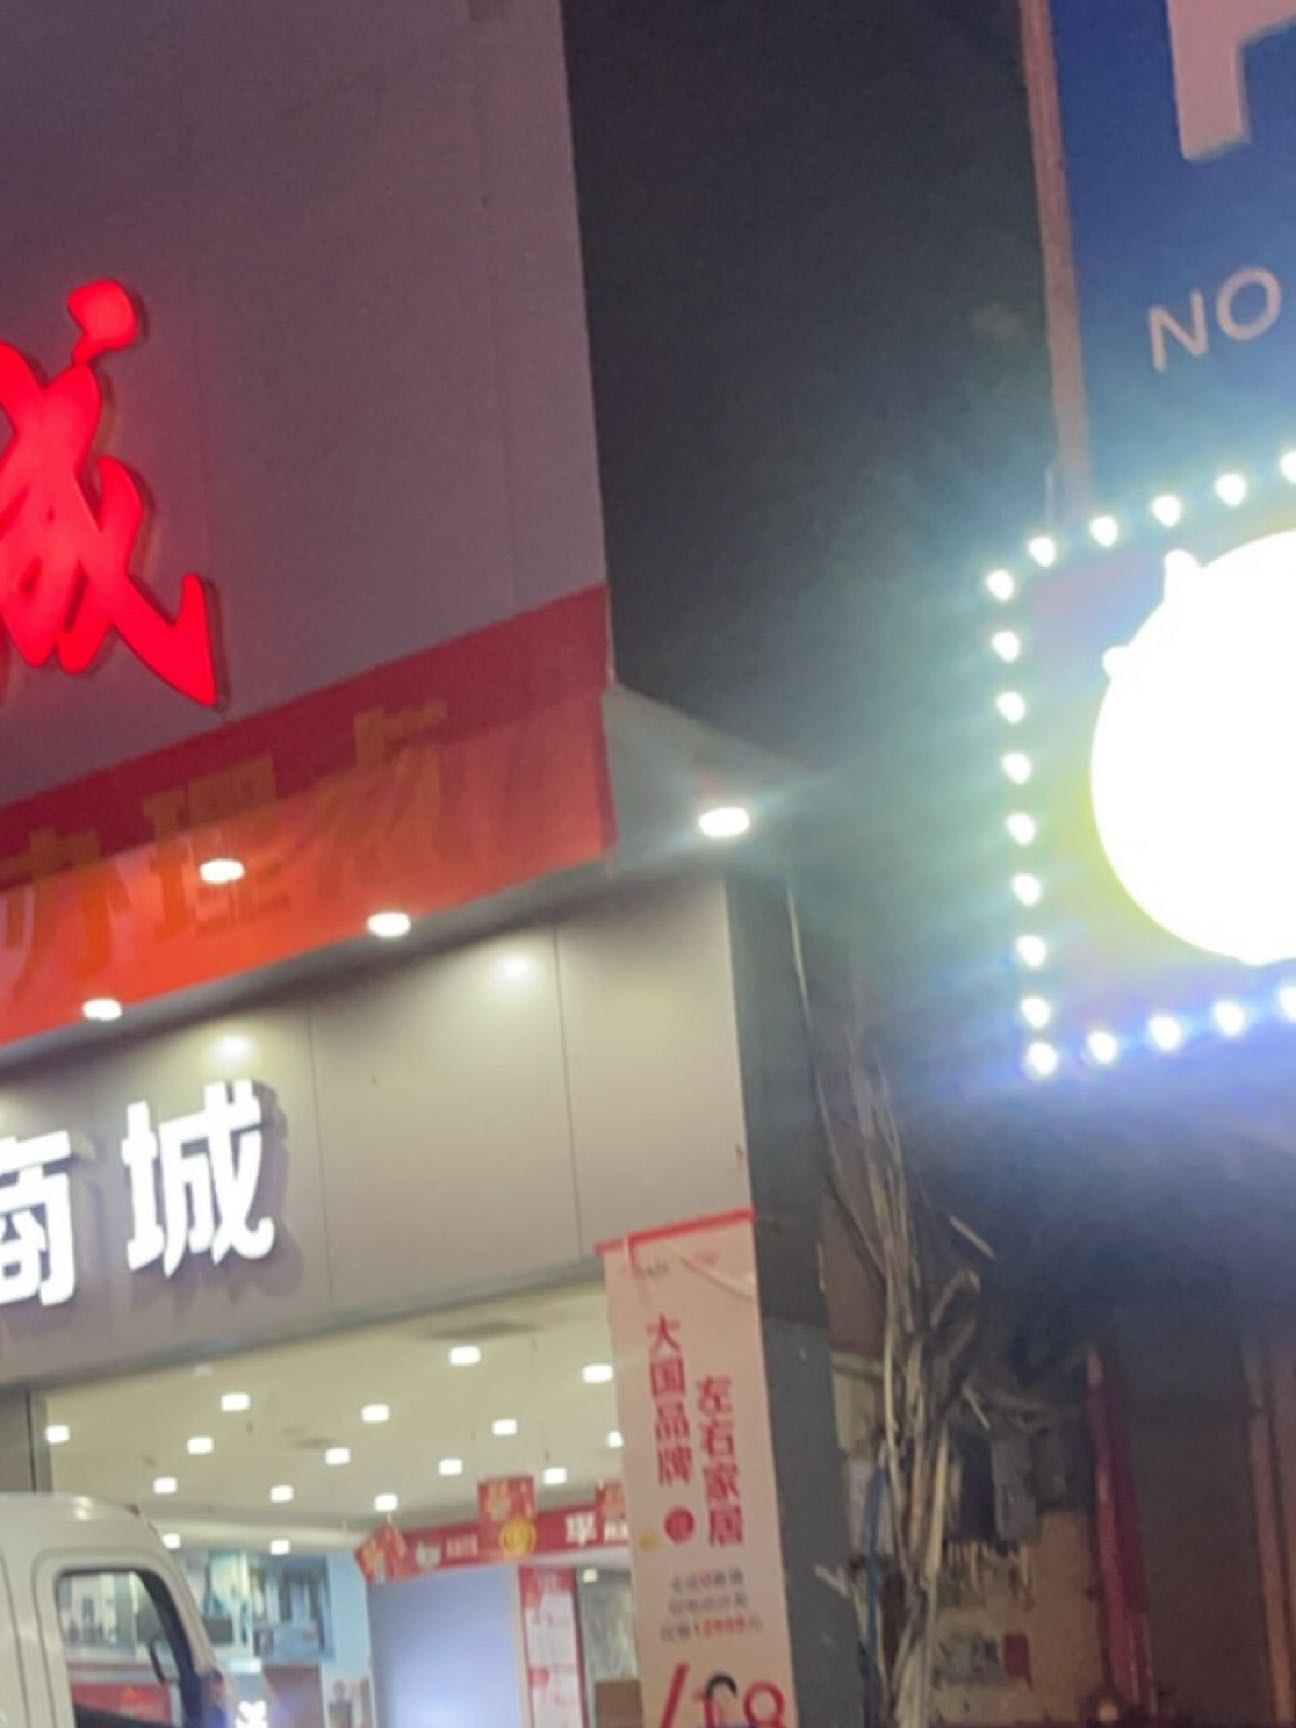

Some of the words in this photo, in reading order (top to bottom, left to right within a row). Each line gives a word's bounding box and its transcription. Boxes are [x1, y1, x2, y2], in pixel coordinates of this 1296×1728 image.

[1148, 266, 1282, 373] NO
[646, 1313, 694, 1487] 大国品牌
[695, 1375, 744, 1547] 左右家居
